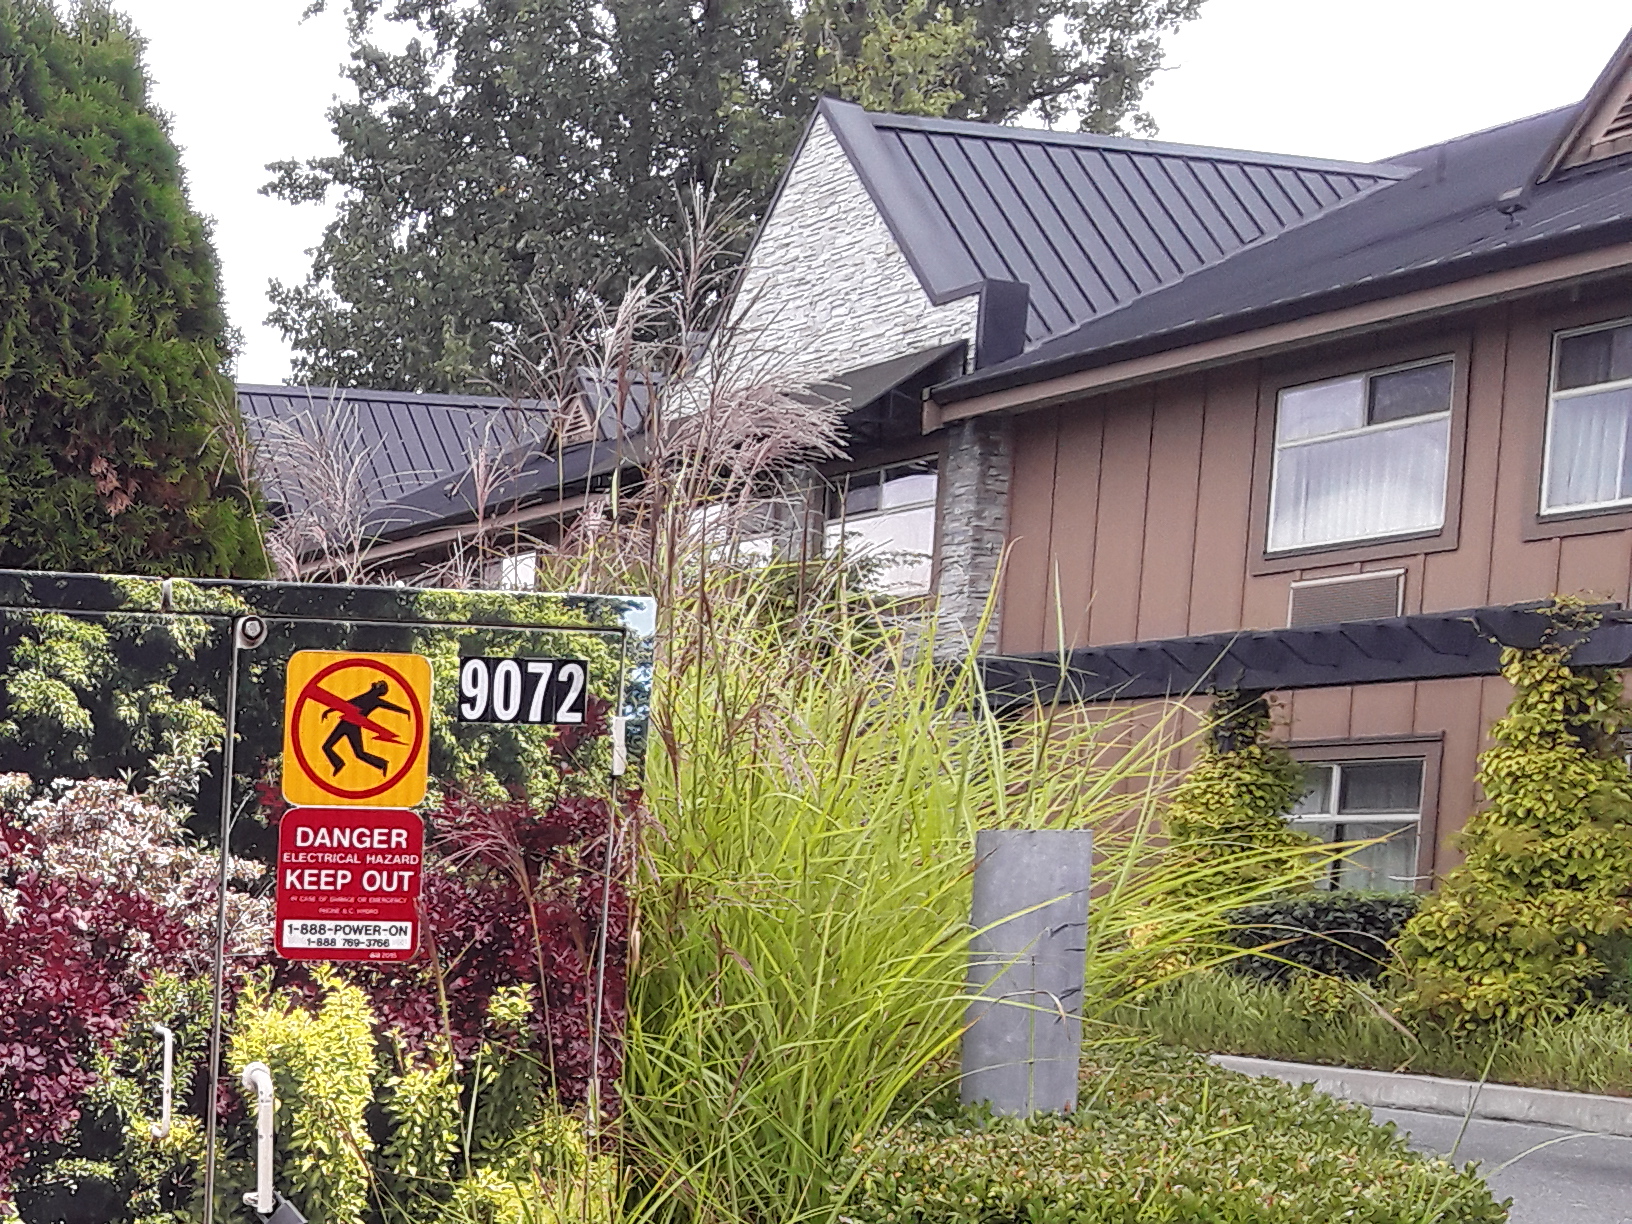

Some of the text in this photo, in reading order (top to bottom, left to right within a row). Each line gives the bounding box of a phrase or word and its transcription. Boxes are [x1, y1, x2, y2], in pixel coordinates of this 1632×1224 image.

[461, 658, 584, 722] 9072
[295, 826, 408, 849] DANGER
[282, 852, 419, 865] ELECTRICAL HAZARD
[285, 868, 415, 892] KEEP OUT
[287, 924, 409, 936] 1-888-POWER-ON
[307, 938, 336, 947] 1-888
